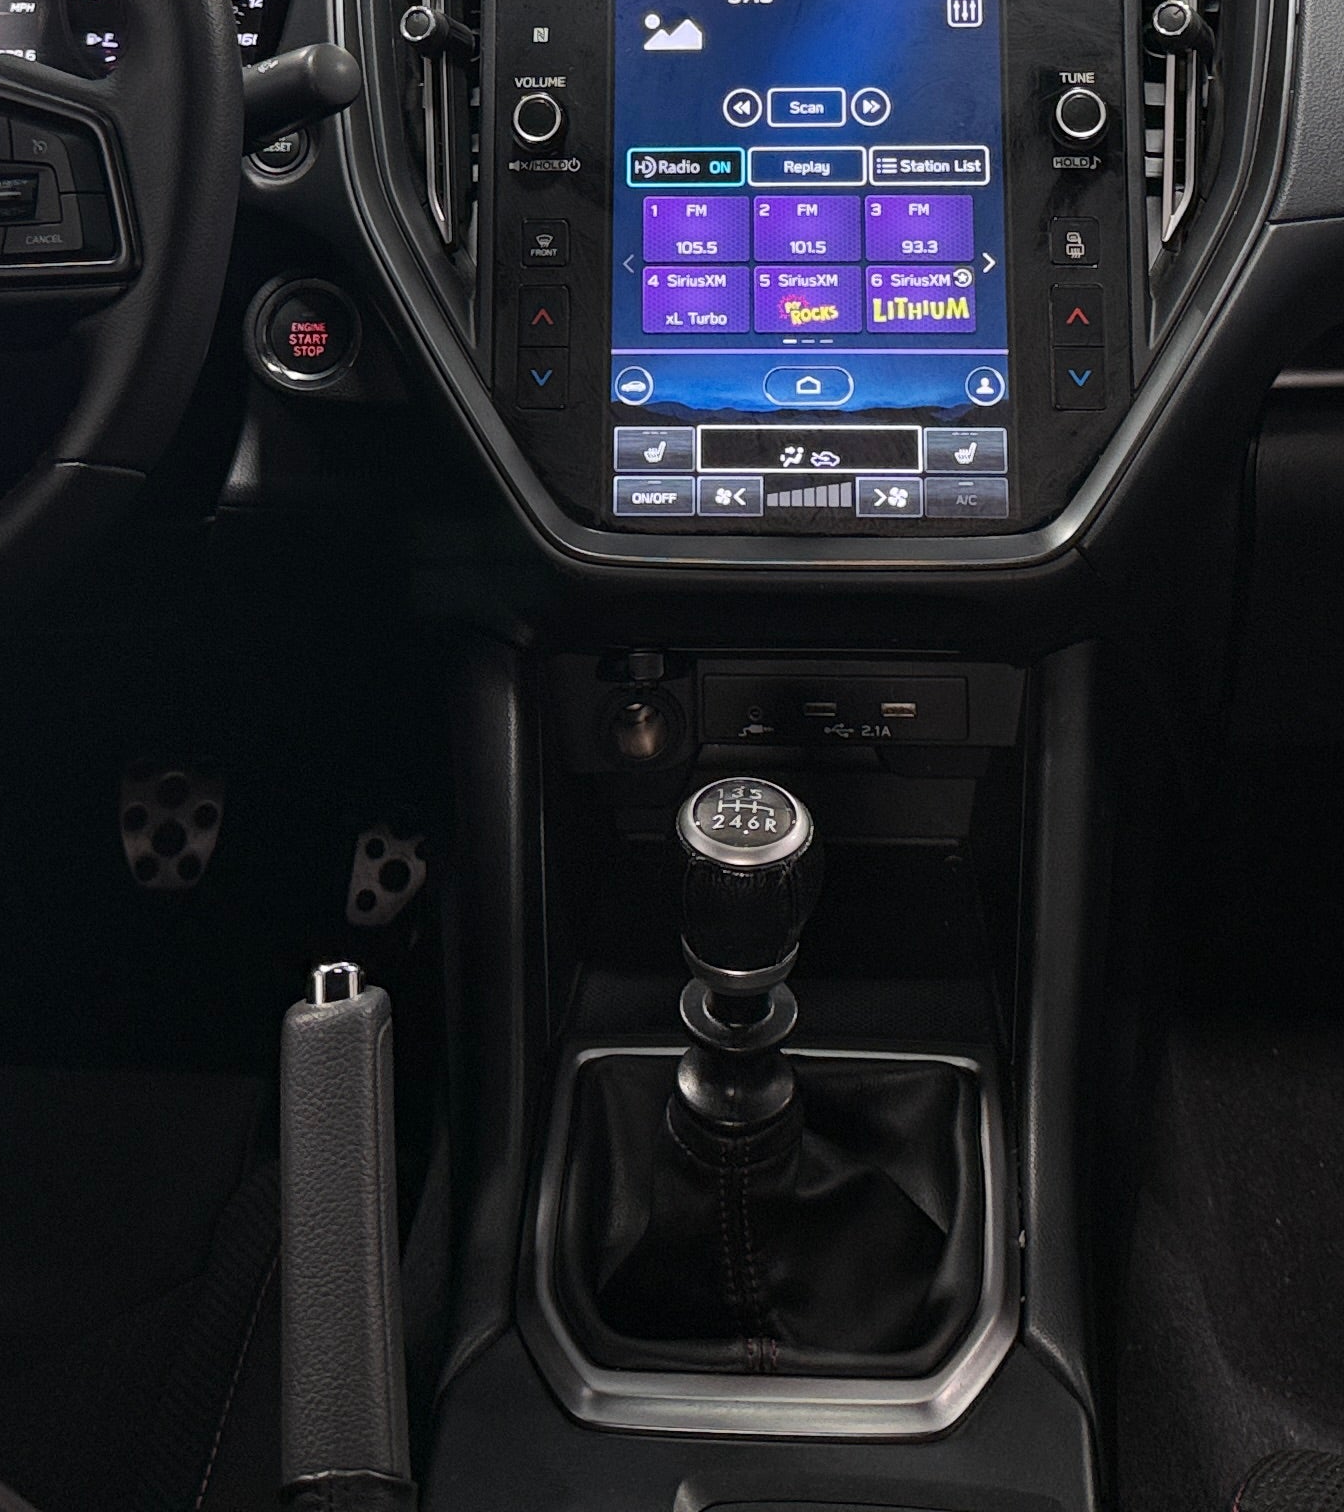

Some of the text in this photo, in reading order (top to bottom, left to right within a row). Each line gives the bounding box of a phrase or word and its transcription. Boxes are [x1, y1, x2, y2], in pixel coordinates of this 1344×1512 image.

[9, 2, 35, 14] MPH
[515, 76, 567, 88] VOLUME
[1059, 72, 1096, 84] TUNE
[789, 101, 825, 115] Scan
[658, 159, 701, 174] Radio
[709, 160, 732, 174] ON
[783, 160, 831, 177] Replay
[899, 158, 982, 173] Station List
[650, 204, 708, 217] 1 FM
[759, 203, 818, 217] 2 FM
[870, 203, 930, 217] 3 FM
[25, 234, 64, 245] CANCEL
[530, 248, 558, 257] FRONT
[675, 241, 718, 255] 105.5
[789, 241, 827, 254] 101.5
[901, 240, 939, 254] 93.3
[647, 274, 727, 288] 4 SiriusXM
[759, 274, 838, 287] 5 SiriusXM
[871, 273, 951, 287] 6 SiriusXM
[665, 312, 728, 326] xL Turbo
[790, 304, 839, 326] ROCKS
[291, 321, 327, 333] ENGINE
[288, 333, 329, 345] START
[293, 345, 325, 357] STOP
[632, 492, 677, 505] ON/OFF
[956, 493, 978, 506] A/C
[860, 724, 891, 738] 2.1A
